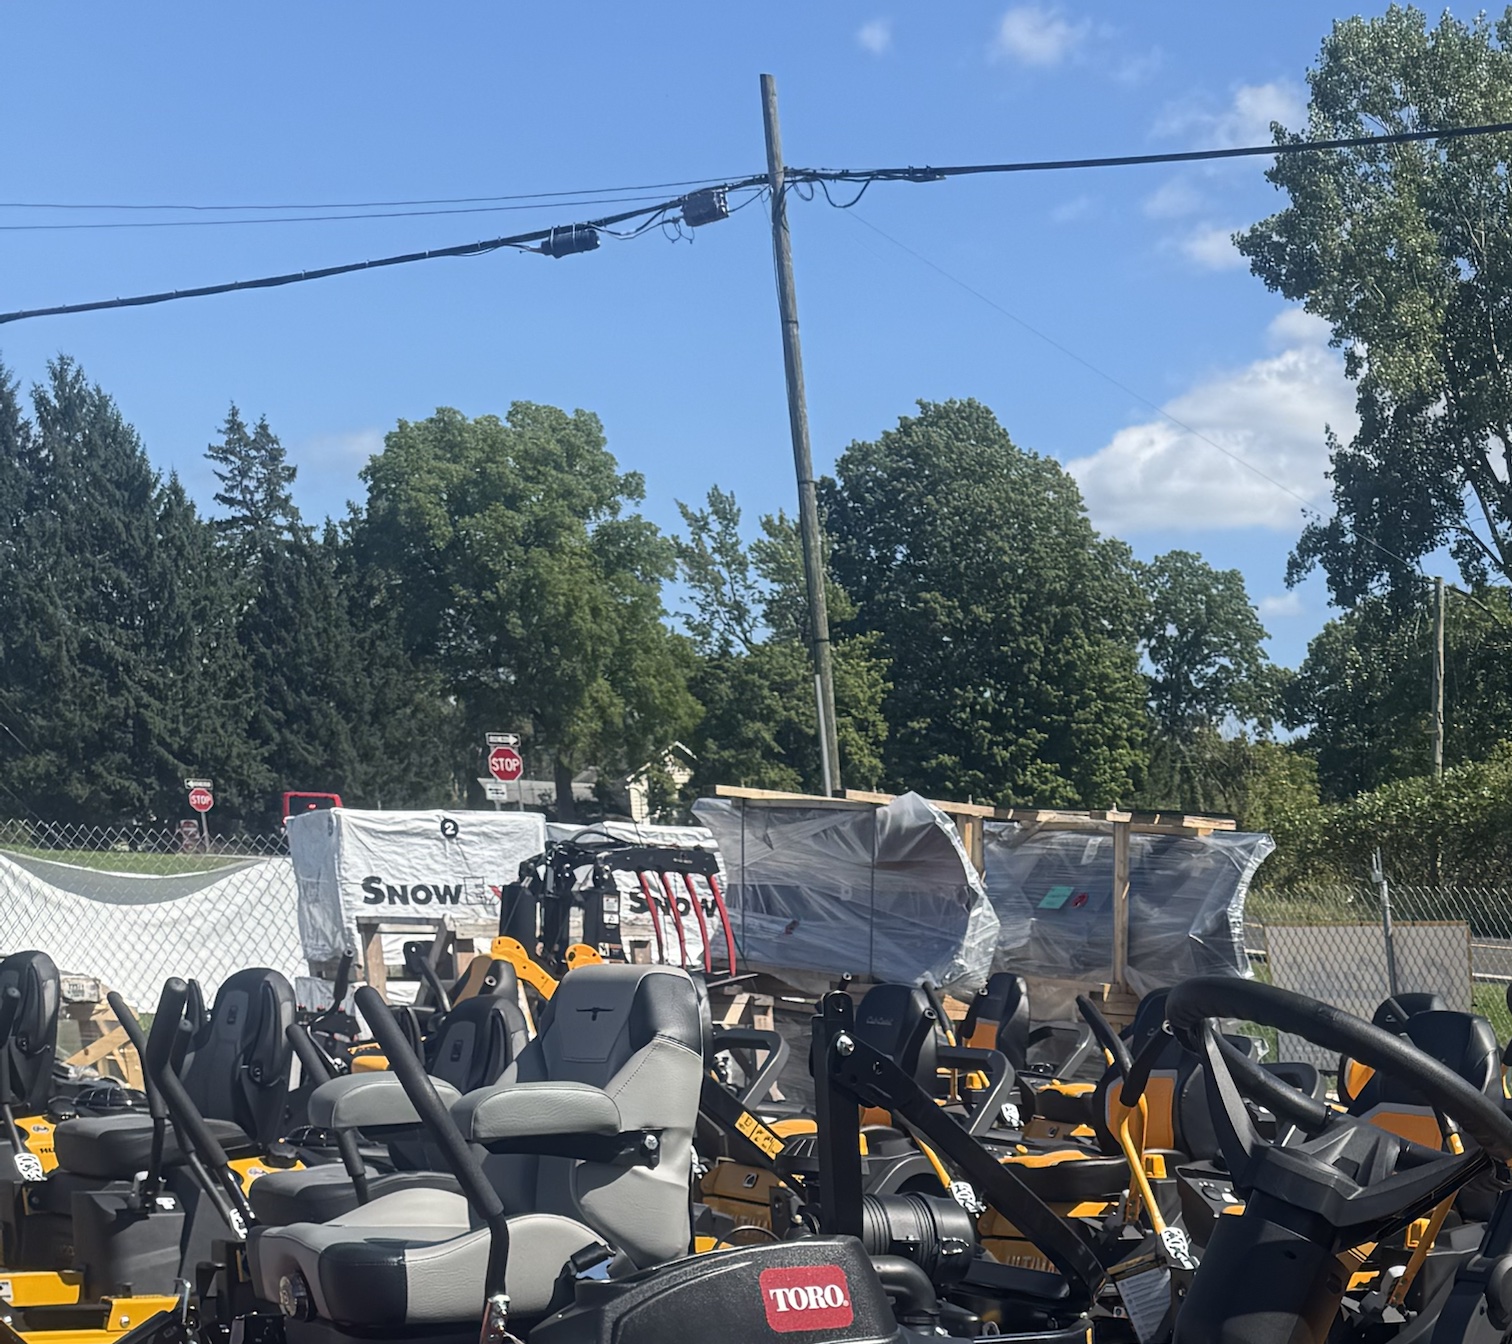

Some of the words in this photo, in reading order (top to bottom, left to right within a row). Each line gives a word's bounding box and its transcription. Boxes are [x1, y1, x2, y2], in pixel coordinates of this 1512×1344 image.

[491, 757, 520, 772] STOP
[190, 794, 211, 806] STOP
[444, 821, 456, 835] 2
[768, 1284, 845, 1312] TORO
